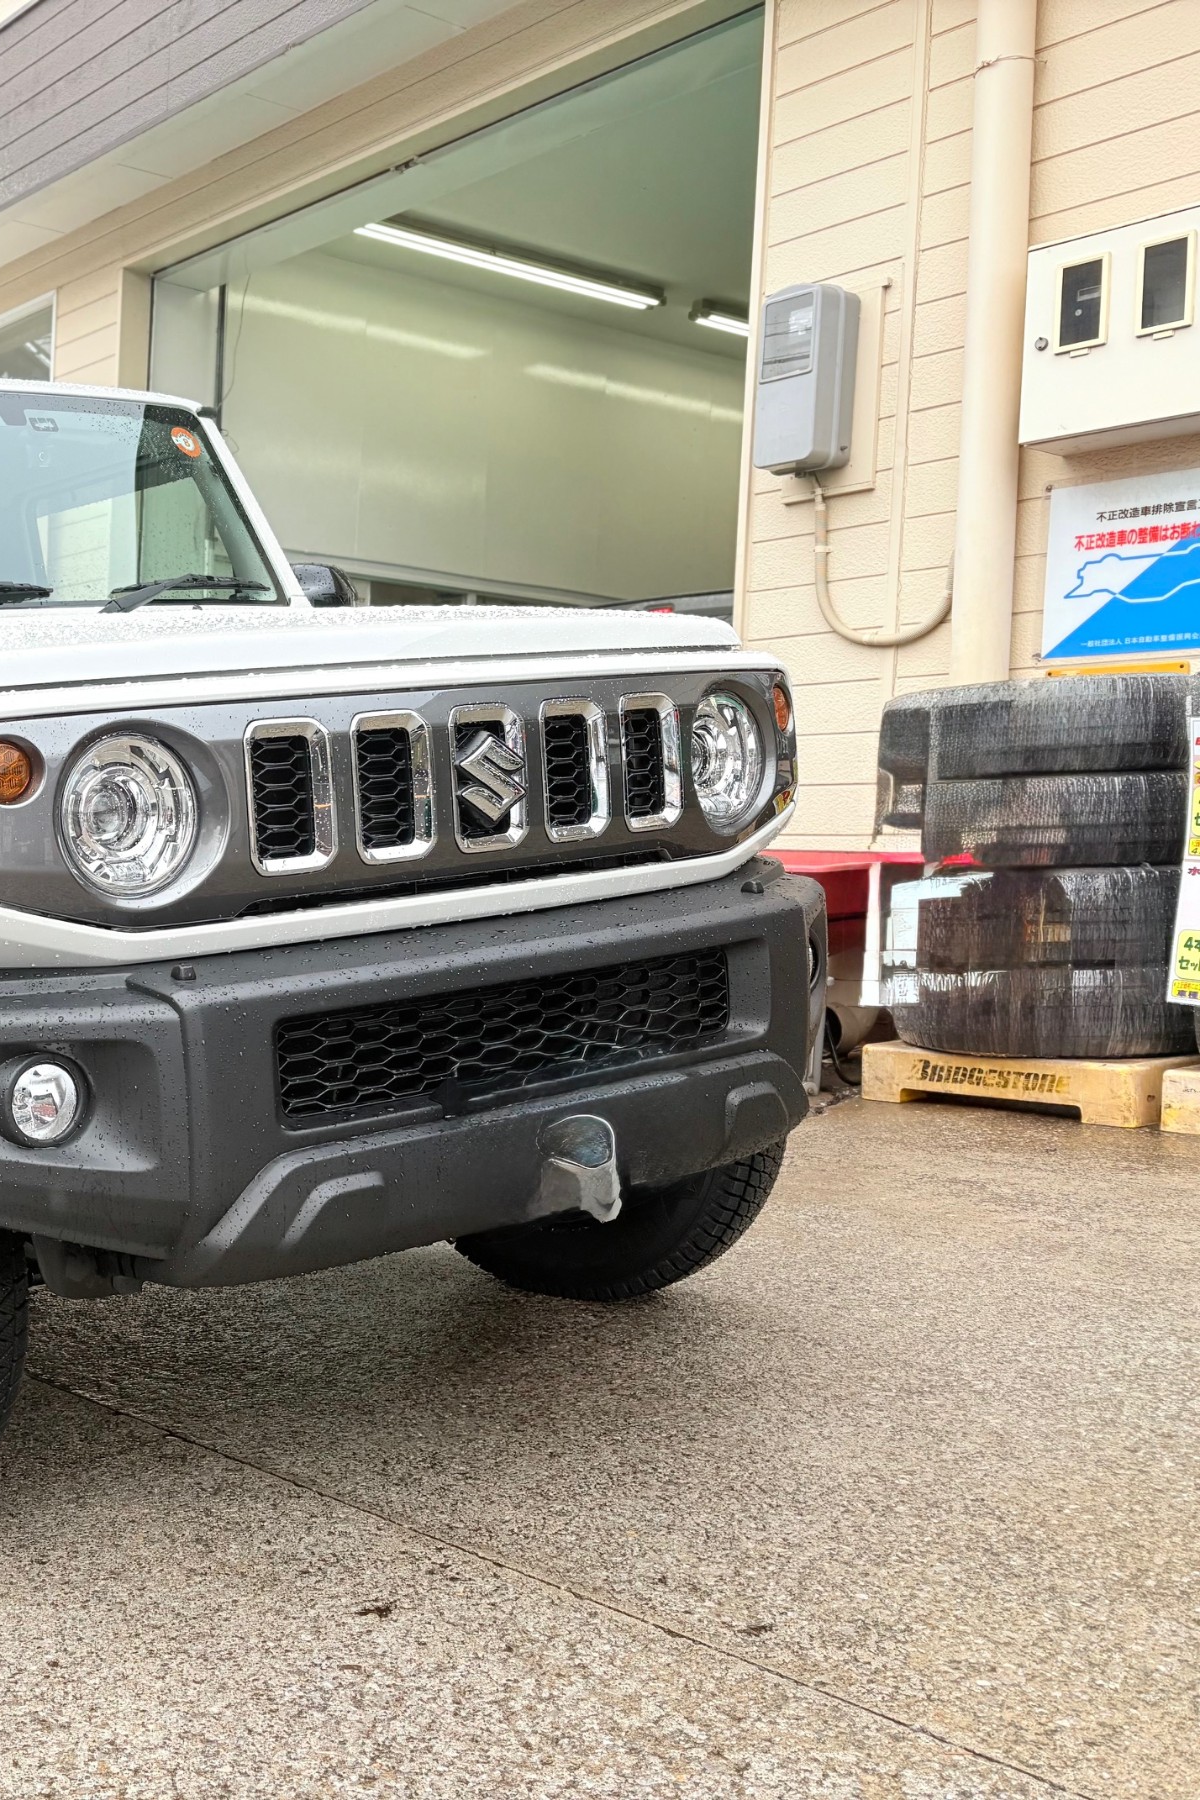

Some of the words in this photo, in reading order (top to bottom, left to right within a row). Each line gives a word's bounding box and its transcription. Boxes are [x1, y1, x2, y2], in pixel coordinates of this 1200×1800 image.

[1096, 499, 1200, 522] 不正改造車排除宣言
[1124, 631, 1200, 645] 日本自動車整備振興会
[911, 1059, 1072, 1094] BRIDGESTONE
